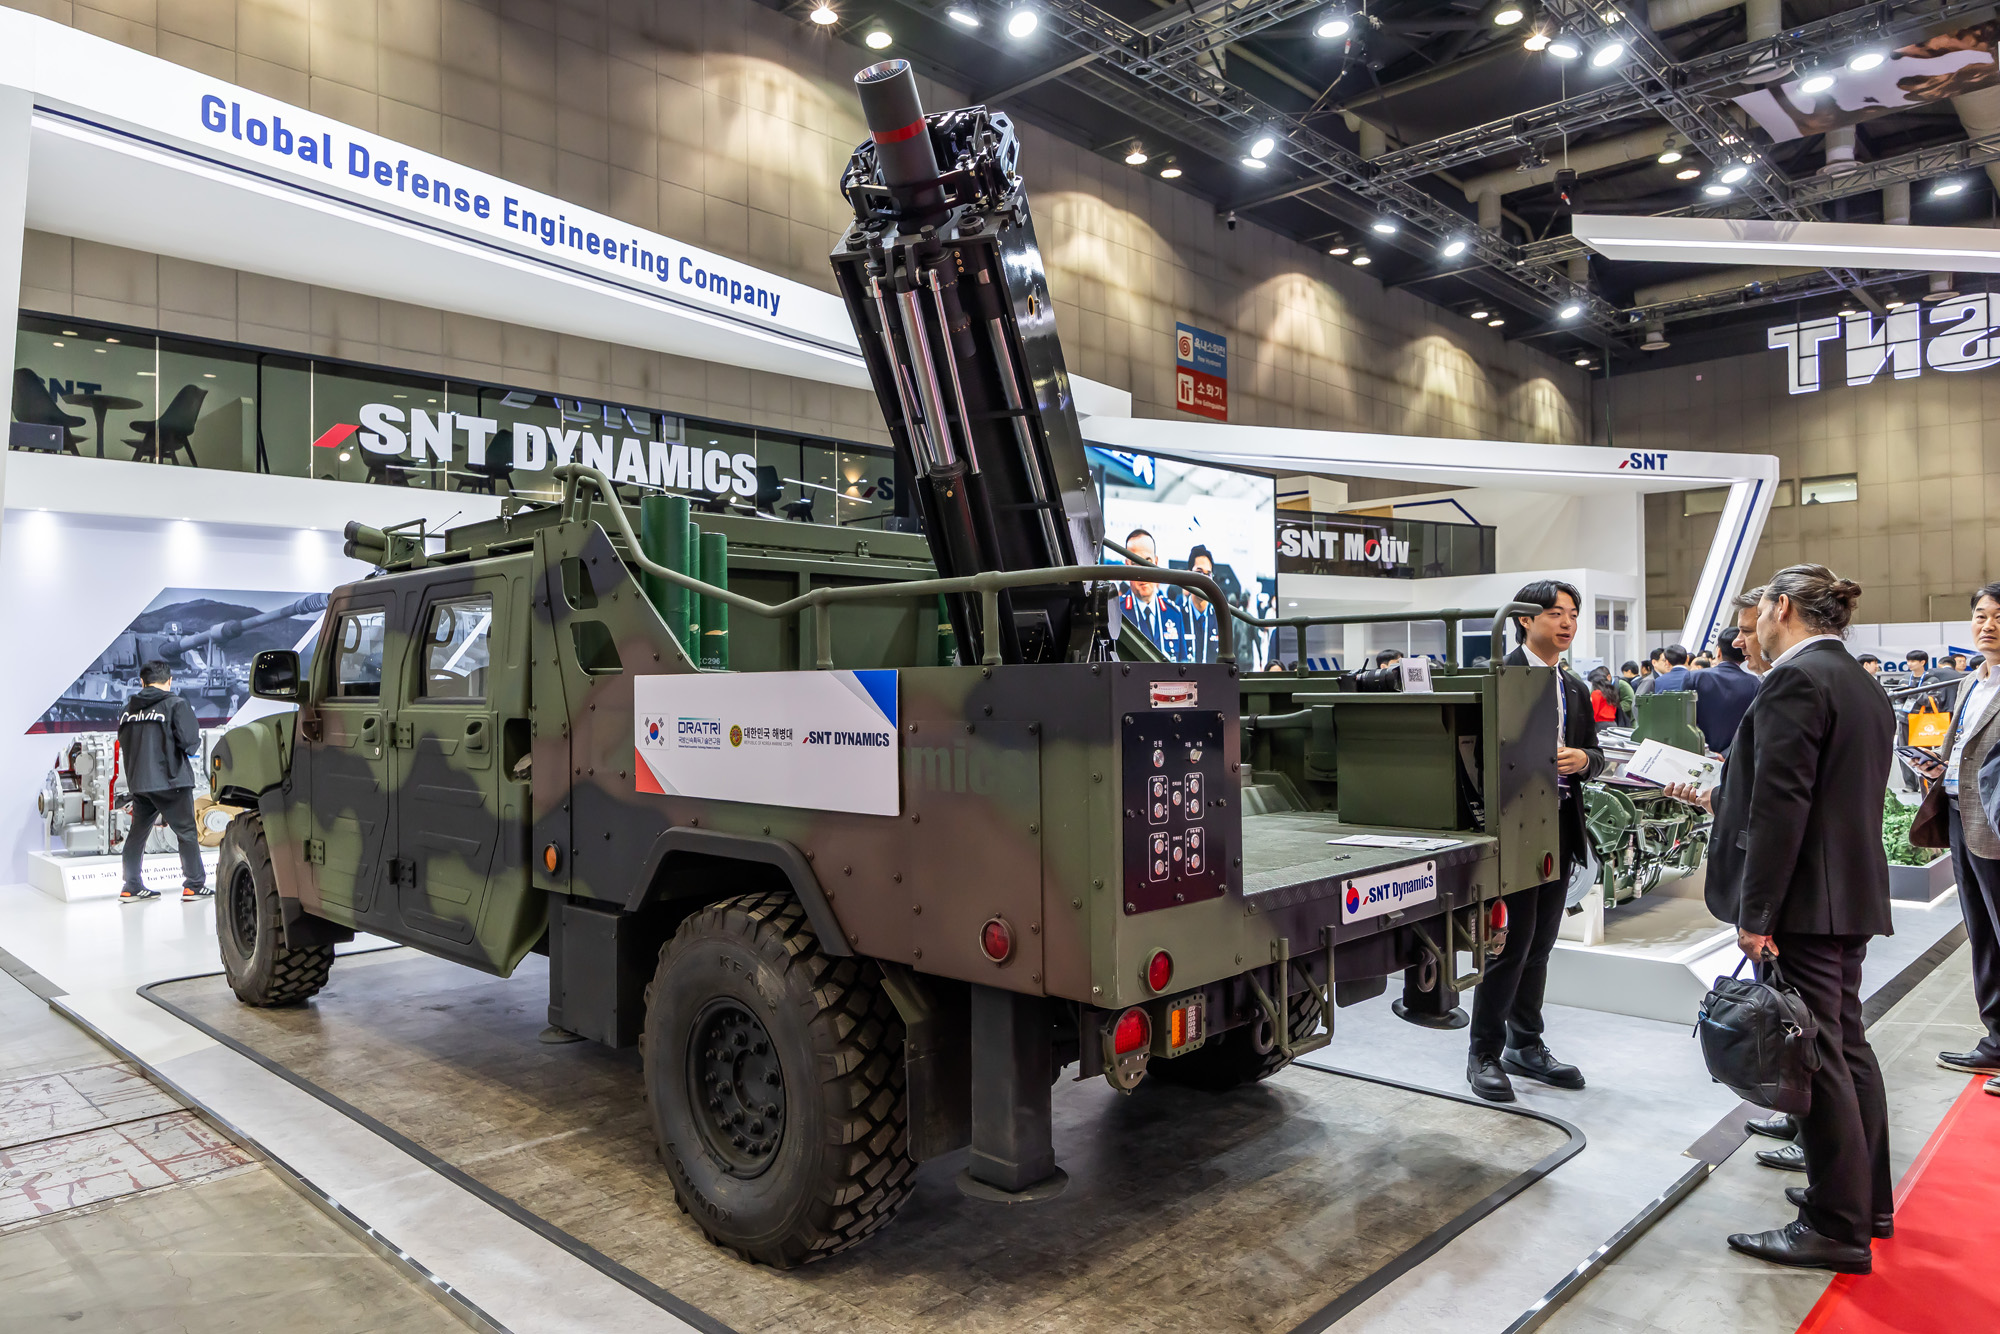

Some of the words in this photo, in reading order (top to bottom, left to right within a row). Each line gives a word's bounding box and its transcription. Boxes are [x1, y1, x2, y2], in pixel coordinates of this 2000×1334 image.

[201, 94, 333, 169] Global
[348, 142, 490, 219] Defense
[503, 196, 669, 282] Engineering
[679, 256, 780, 317] Company
[1197, 382, 1222, 400] 소화기
[359, 403, 498, 466] SNT
[513, 422, 758, 497] DYNAMICS
[1630, 452, 1668, 470] SNT
[1281, 528, 1339, 560] SNT
[1344, 532, 1410, 564] Motiv
[678, 718, 720, 735] DRATRI
[743, 727, 770, 740] 대한민국
[771, 728, 793, 741] 해병대
[809, 731, 832, 745] SNT
[834, 731, 890, 747] DYNAMICS
[1369, 883, 1390, 903] SNT
[1392, 875, 1434, 902] Dynamics
